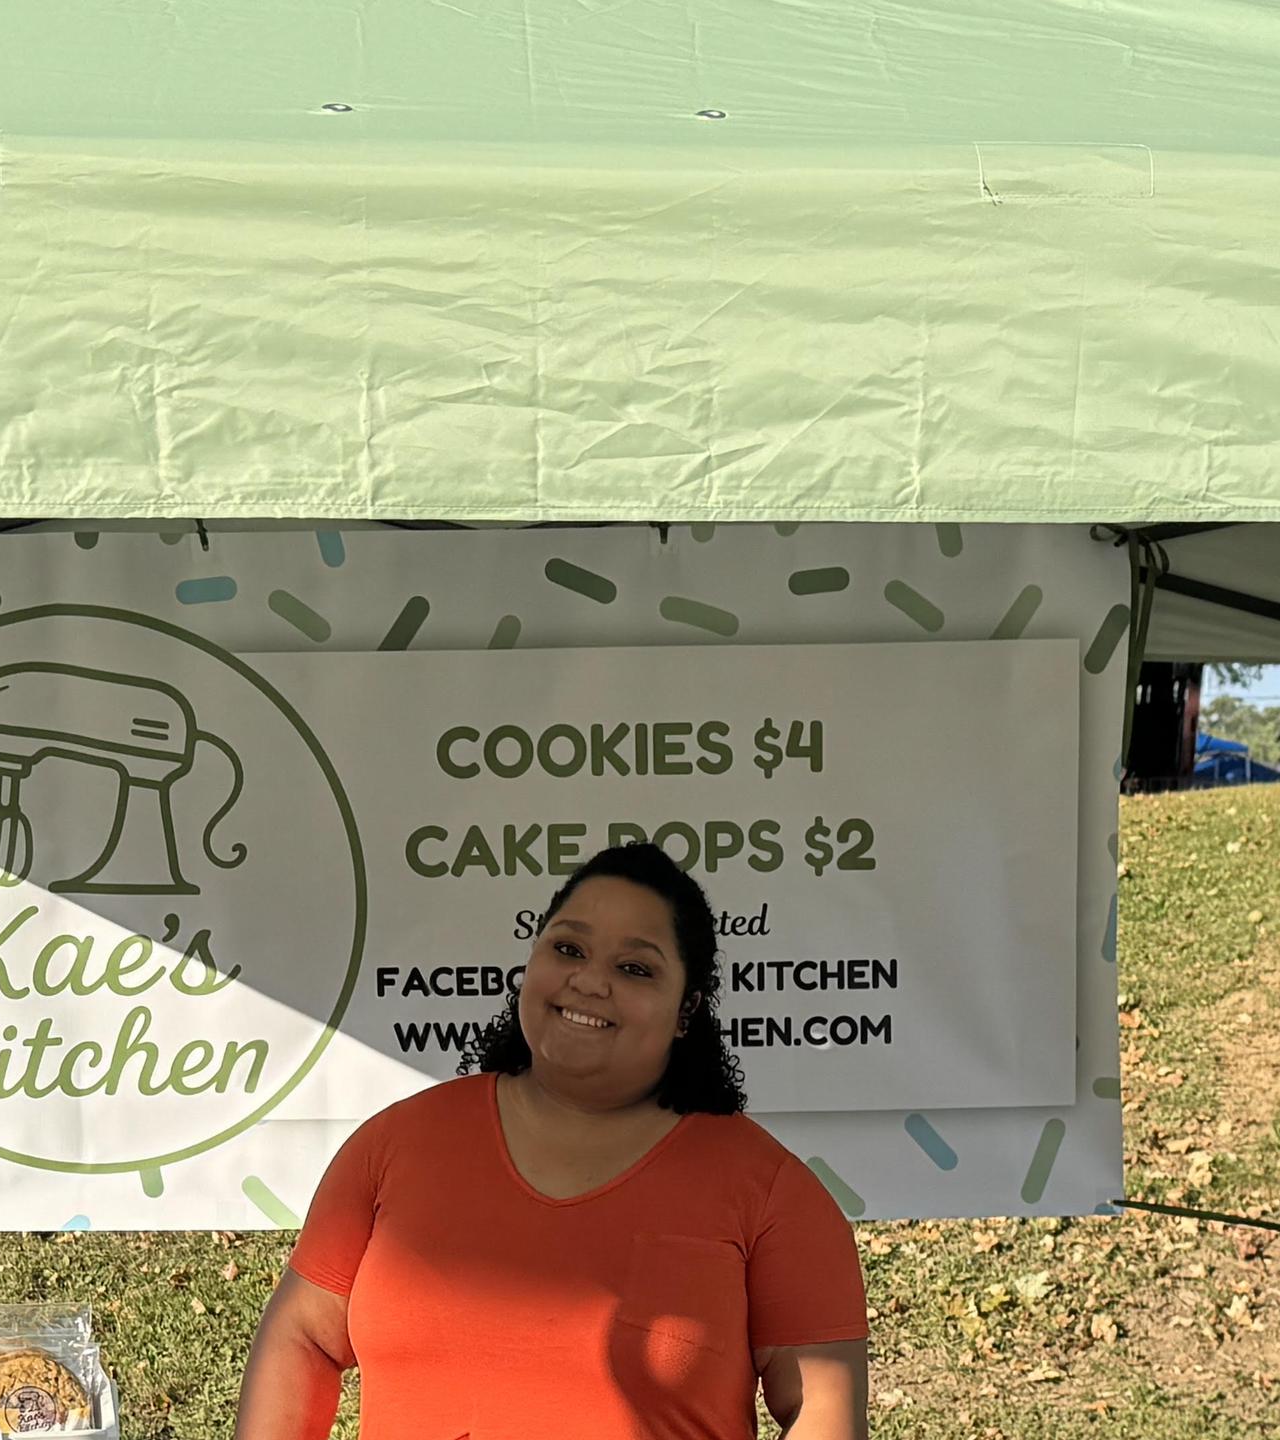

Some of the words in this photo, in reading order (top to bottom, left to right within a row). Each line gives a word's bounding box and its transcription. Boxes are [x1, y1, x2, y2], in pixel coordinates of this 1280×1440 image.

[436, 720, 733, 779] COOKIES
[754, 717, 823, 779] $4
[405, 823, 587, 878] CAKE
[804, 816, 876, 876] $2
[377, 966, 527, 998] FACEBO
[731, 959, 898, 992] KITCHEN
